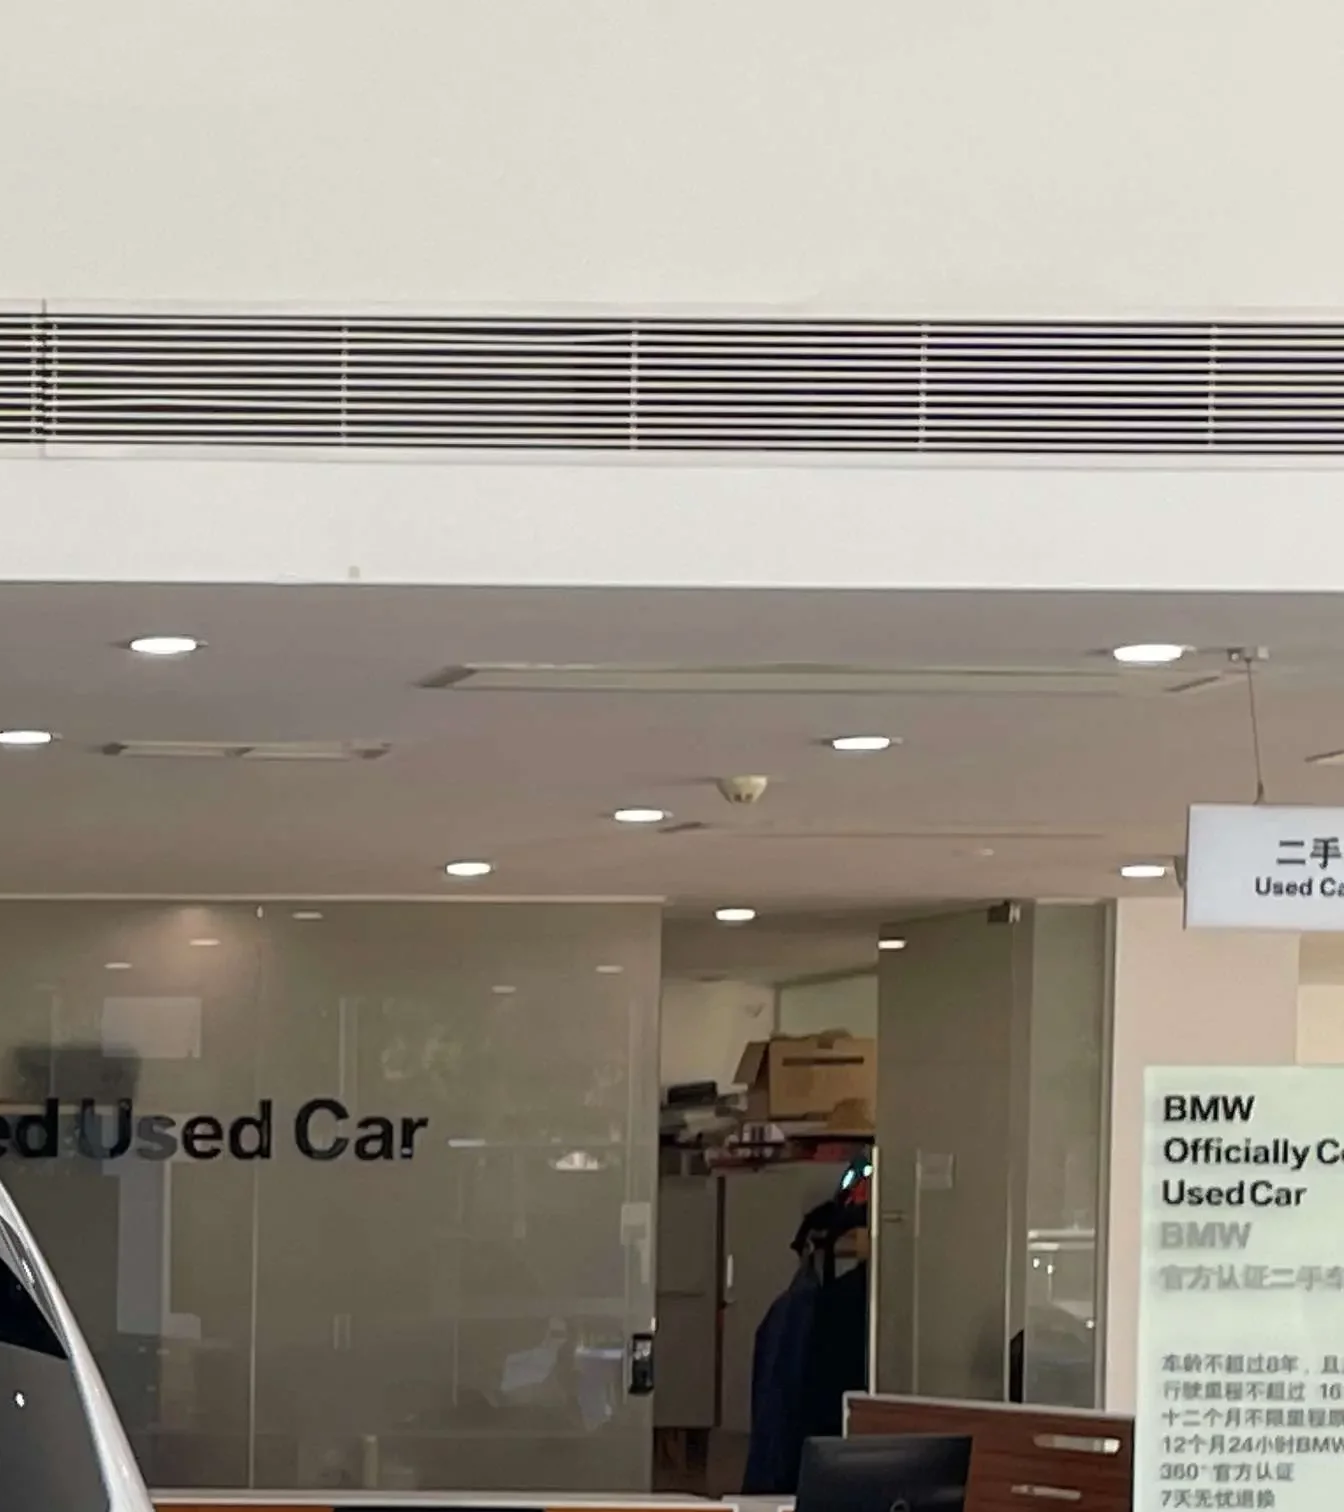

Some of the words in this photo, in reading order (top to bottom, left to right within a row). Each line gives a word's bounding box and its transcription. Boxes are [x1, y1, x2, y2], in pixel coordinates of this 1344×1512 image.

[1255, 876, 1313, 897] Used
[1164, 1095, 1255, 1122] BMW
[79, 1099, 273, 1160] Used
[293, 1099, 429, 1161] Car
[1164, 1136, 1310, 1171] Officially
[1316, 1138, 1344, 1165] C
[1162, 1179, 1245, 1206] Used
[1250, 1180, 1308, 1207] Car
[1162, 1221, 1253, 1249] BMW
